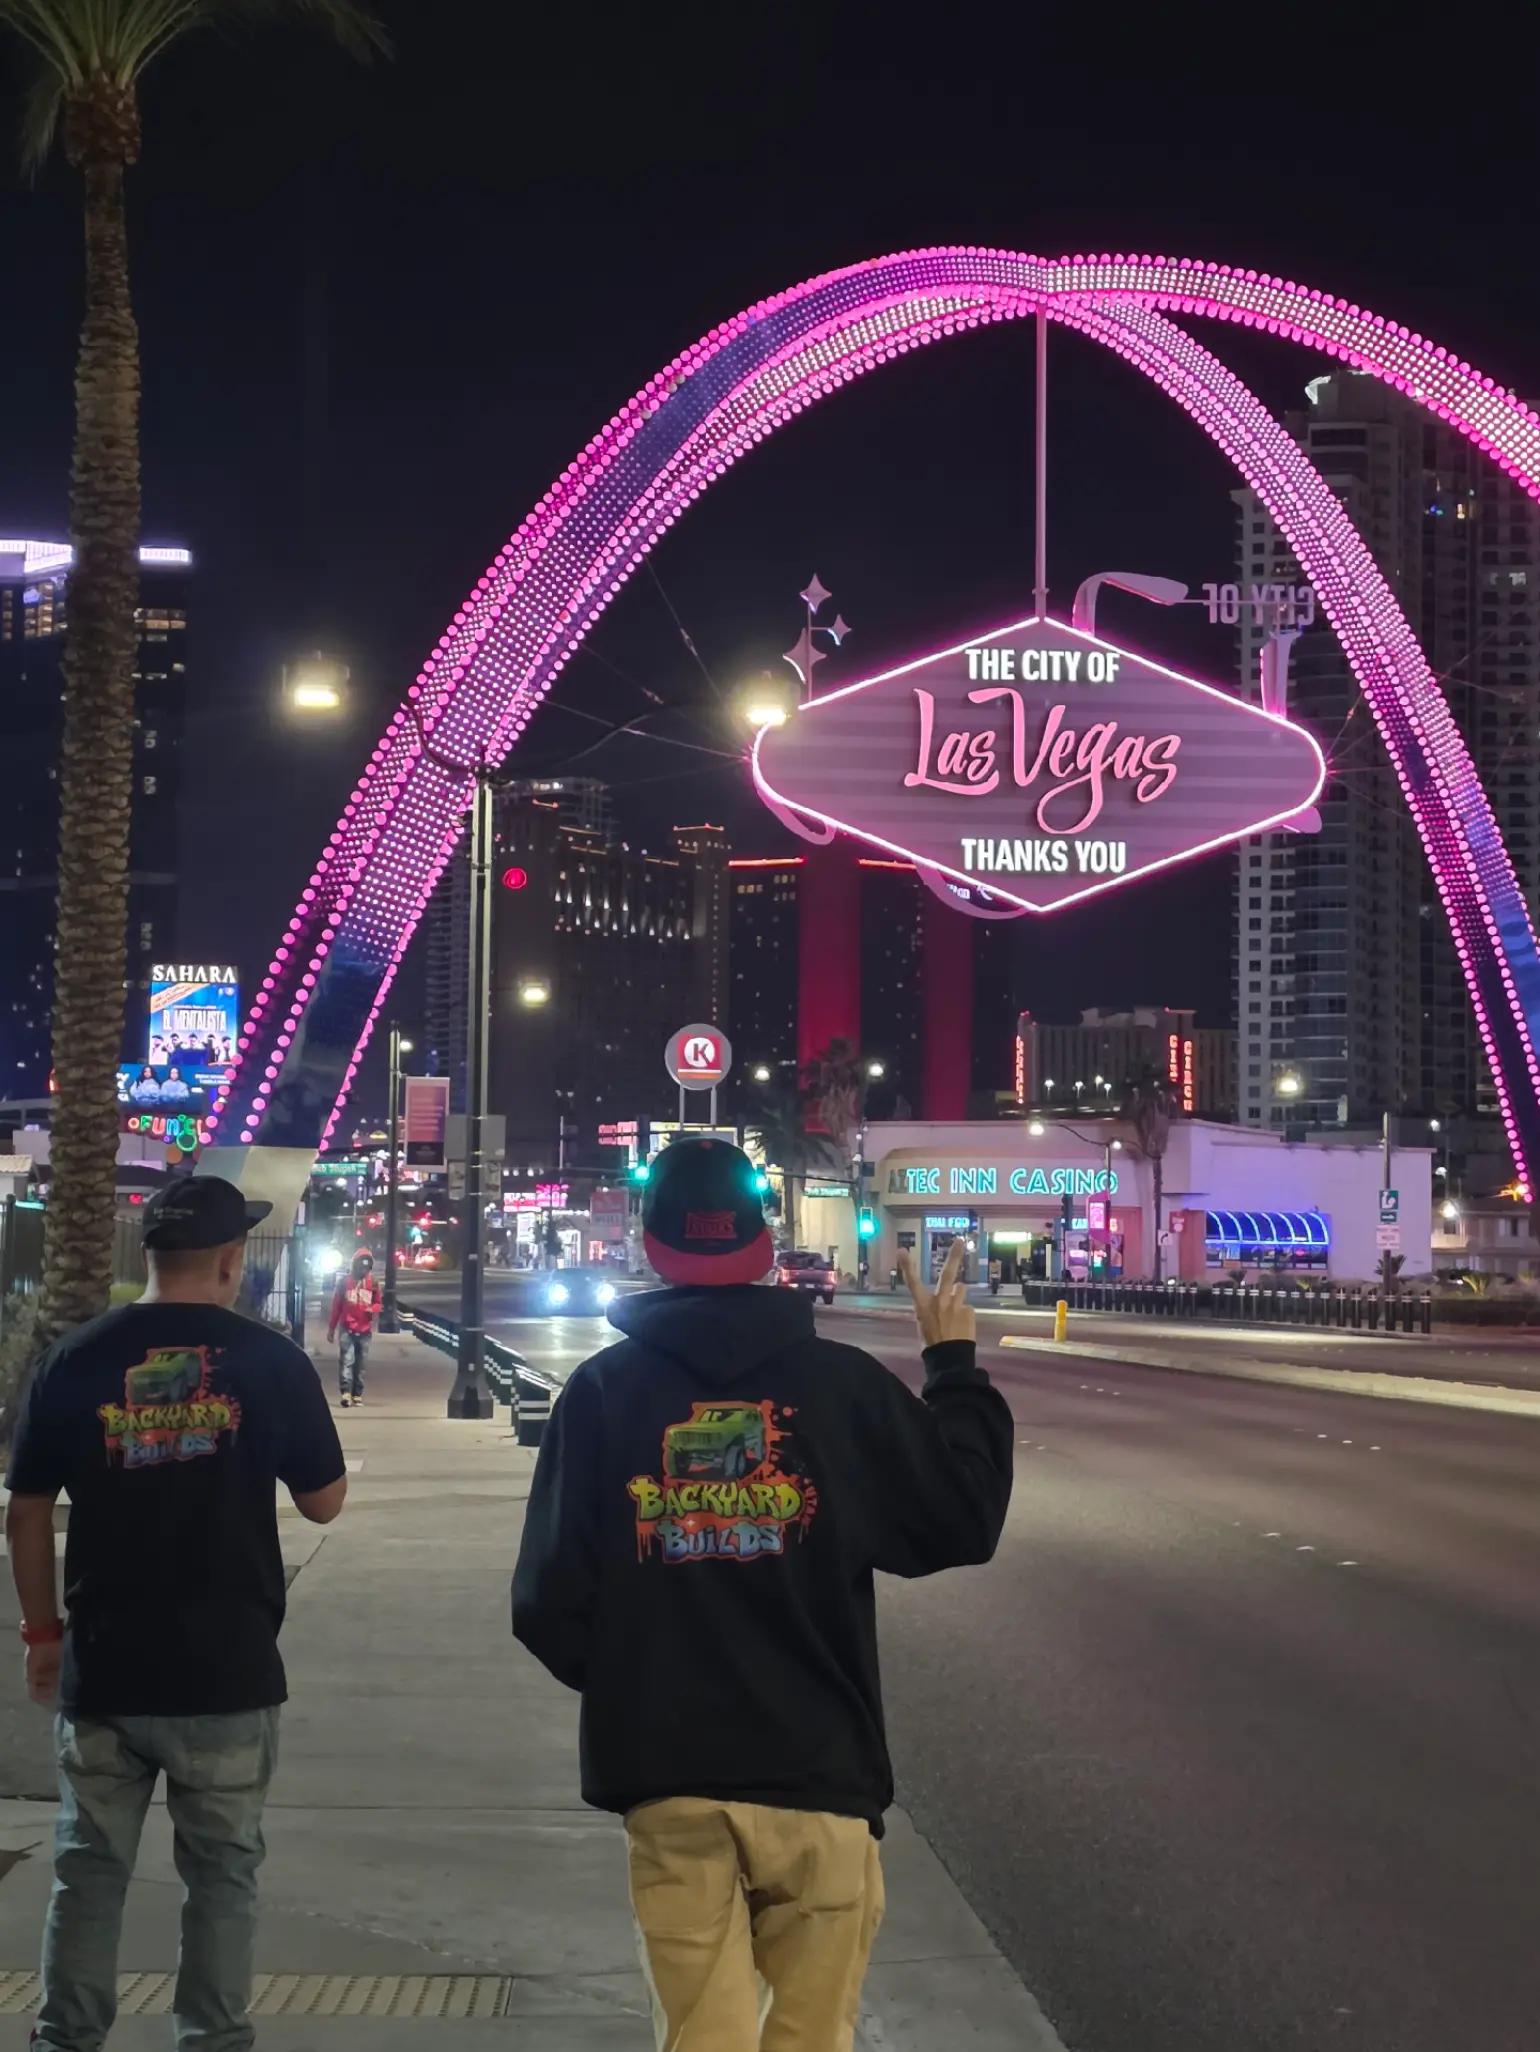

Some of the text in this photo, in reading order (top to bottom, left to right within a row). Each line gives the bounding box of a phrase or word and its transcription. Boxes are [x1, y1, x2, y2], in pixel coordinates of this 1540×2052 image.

[965, 648, 1121, 683] THE CITY OF
[904, 687, 1181, 835] Las Vegas
[961, 838, 1127, 873] THANKS YOU
[152, 964, 237, 983] SAHARA
[693, 1042, 711, 1065] K
[950, 1167, 997, 1194] INN
[1009, 1168, 1118, 1195] CASINO
[101, 1402, 231, 1436] BACKYARD
[629, 1477, 802, 1521] BACKYARD
